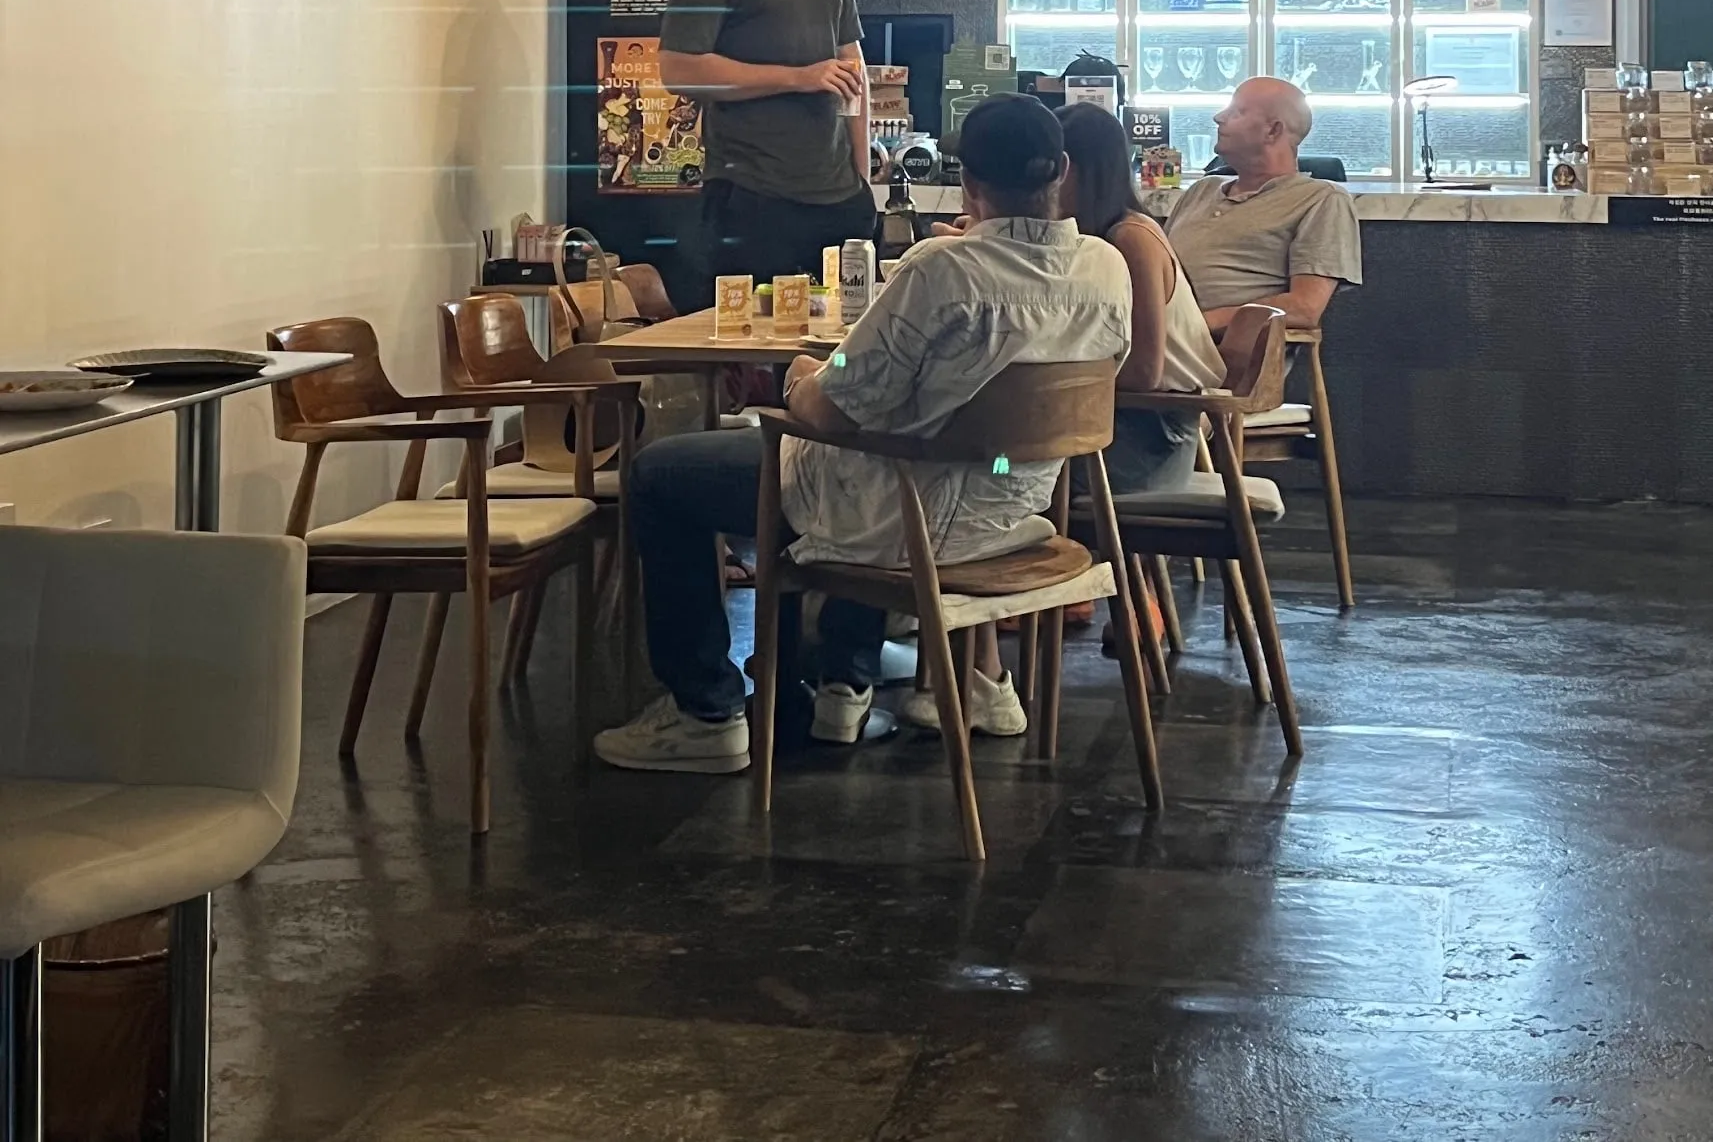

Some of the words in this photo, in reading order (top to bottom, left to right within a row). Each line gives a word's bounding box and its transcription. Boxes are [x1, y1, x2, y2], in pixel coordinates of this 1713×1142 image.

[611, 63, 652, 73] MORE
[604, 78, 638, 88] JUST
[636, 98, 668, 110] COME
[641, 113, 661, 125] TRY
[1133, 114, 1161, 124] 10%
[1132, 125, 1161, 135] OFF
